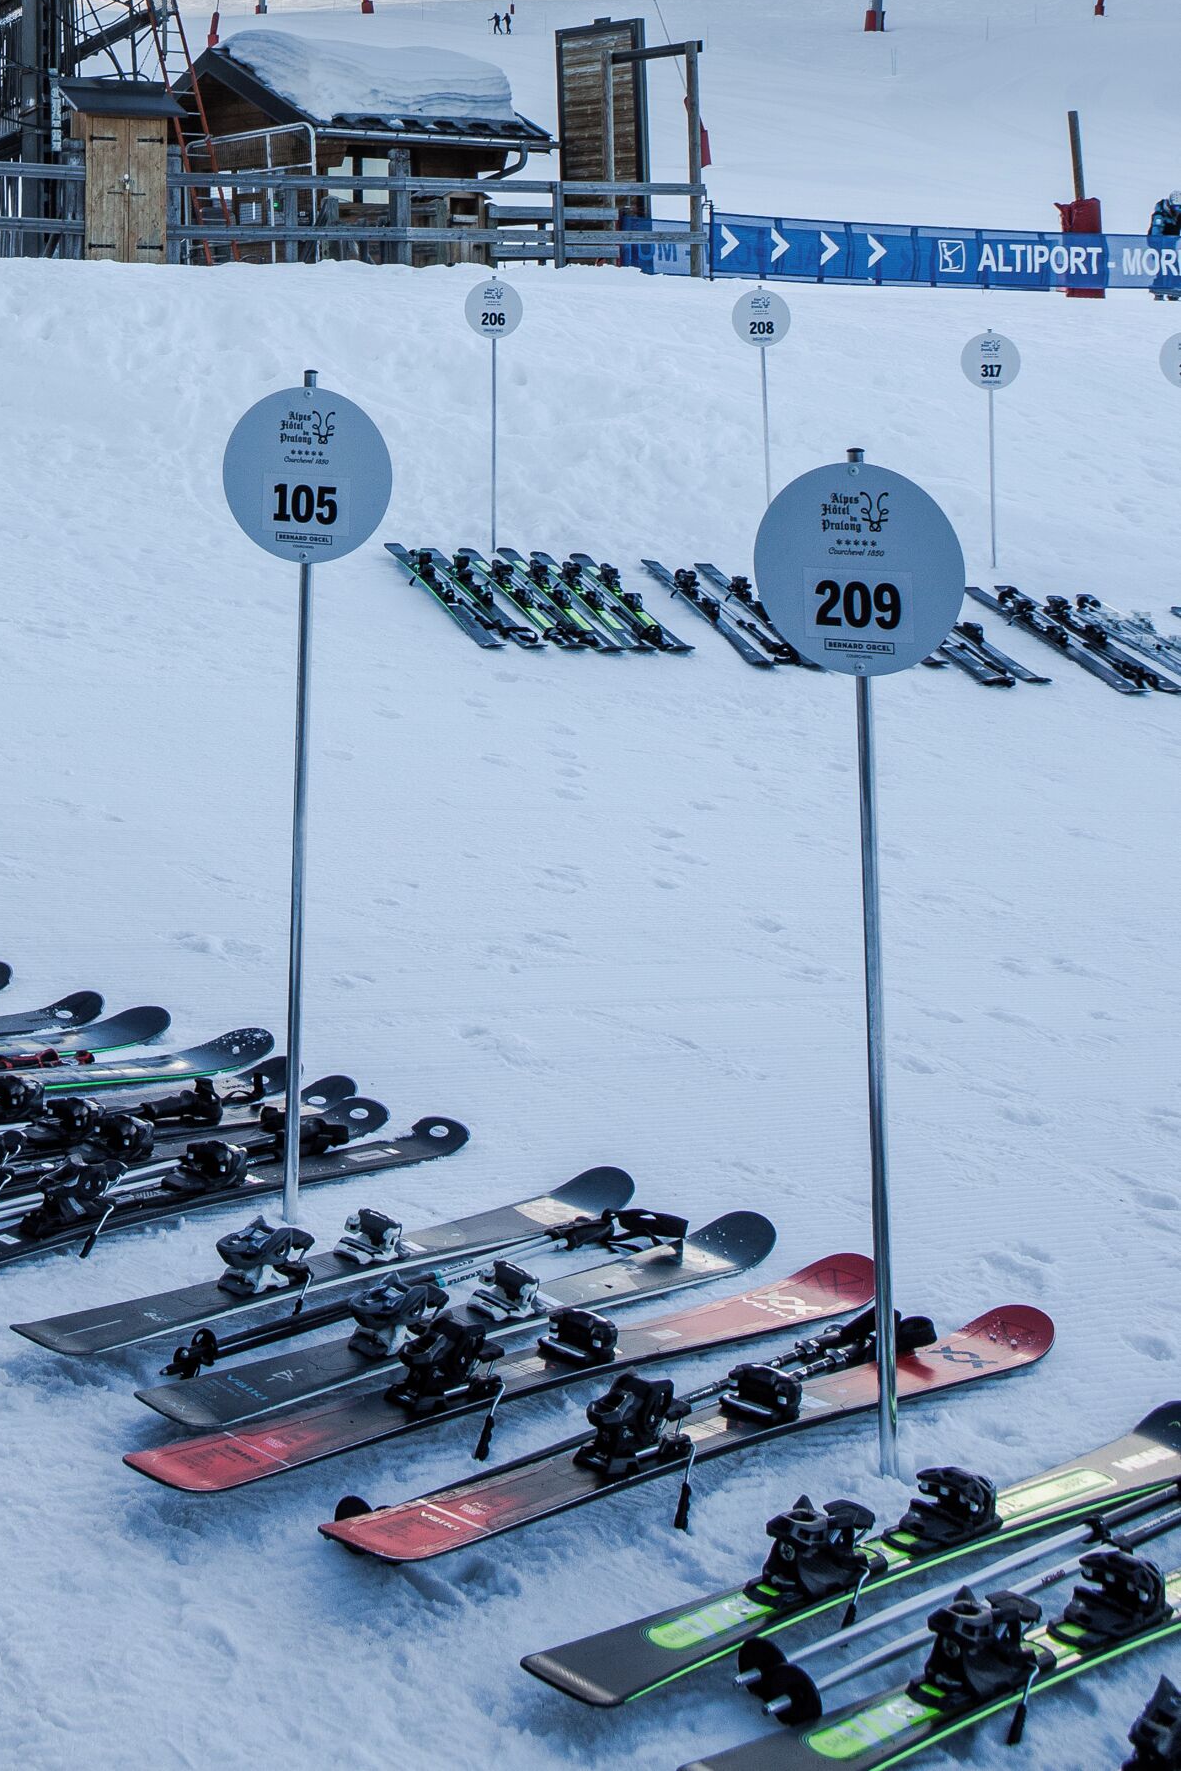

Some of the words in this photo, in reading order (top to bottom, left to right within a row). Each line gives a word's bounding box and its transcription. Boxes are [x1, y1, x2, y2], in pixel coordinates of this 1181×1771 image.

[977, 243, 1103, 276] ALTIPORT
[481, 312, 506, 326] 206
[749, 321, 775, 335] 208
[980, 364, 1002, 378] 317
[288, 410, 312, 421] Alpes
[279, 419, 304, 431] Hôtel
[279, 433, 312, 445] Pralong
[283, 455, 314, 465] Courchevel
[273, 483, 338, 525] 105
[830, 492, 859, 505] Alpes
[820, 503, 850, 516] Hôtel
[821, 519, 862, 533] Pralong
[278, 533, 308, 542] BERNARD
[308, 535, 330, 543] ORCEL
[828, 546, 865, 557] Courchevel
[866, 549, 885, 557] 1850
[815, 579, 902, 631] 209
[828, 640, 864, 650] BERNARD
[865, 643, 892, 652] ORCEL
